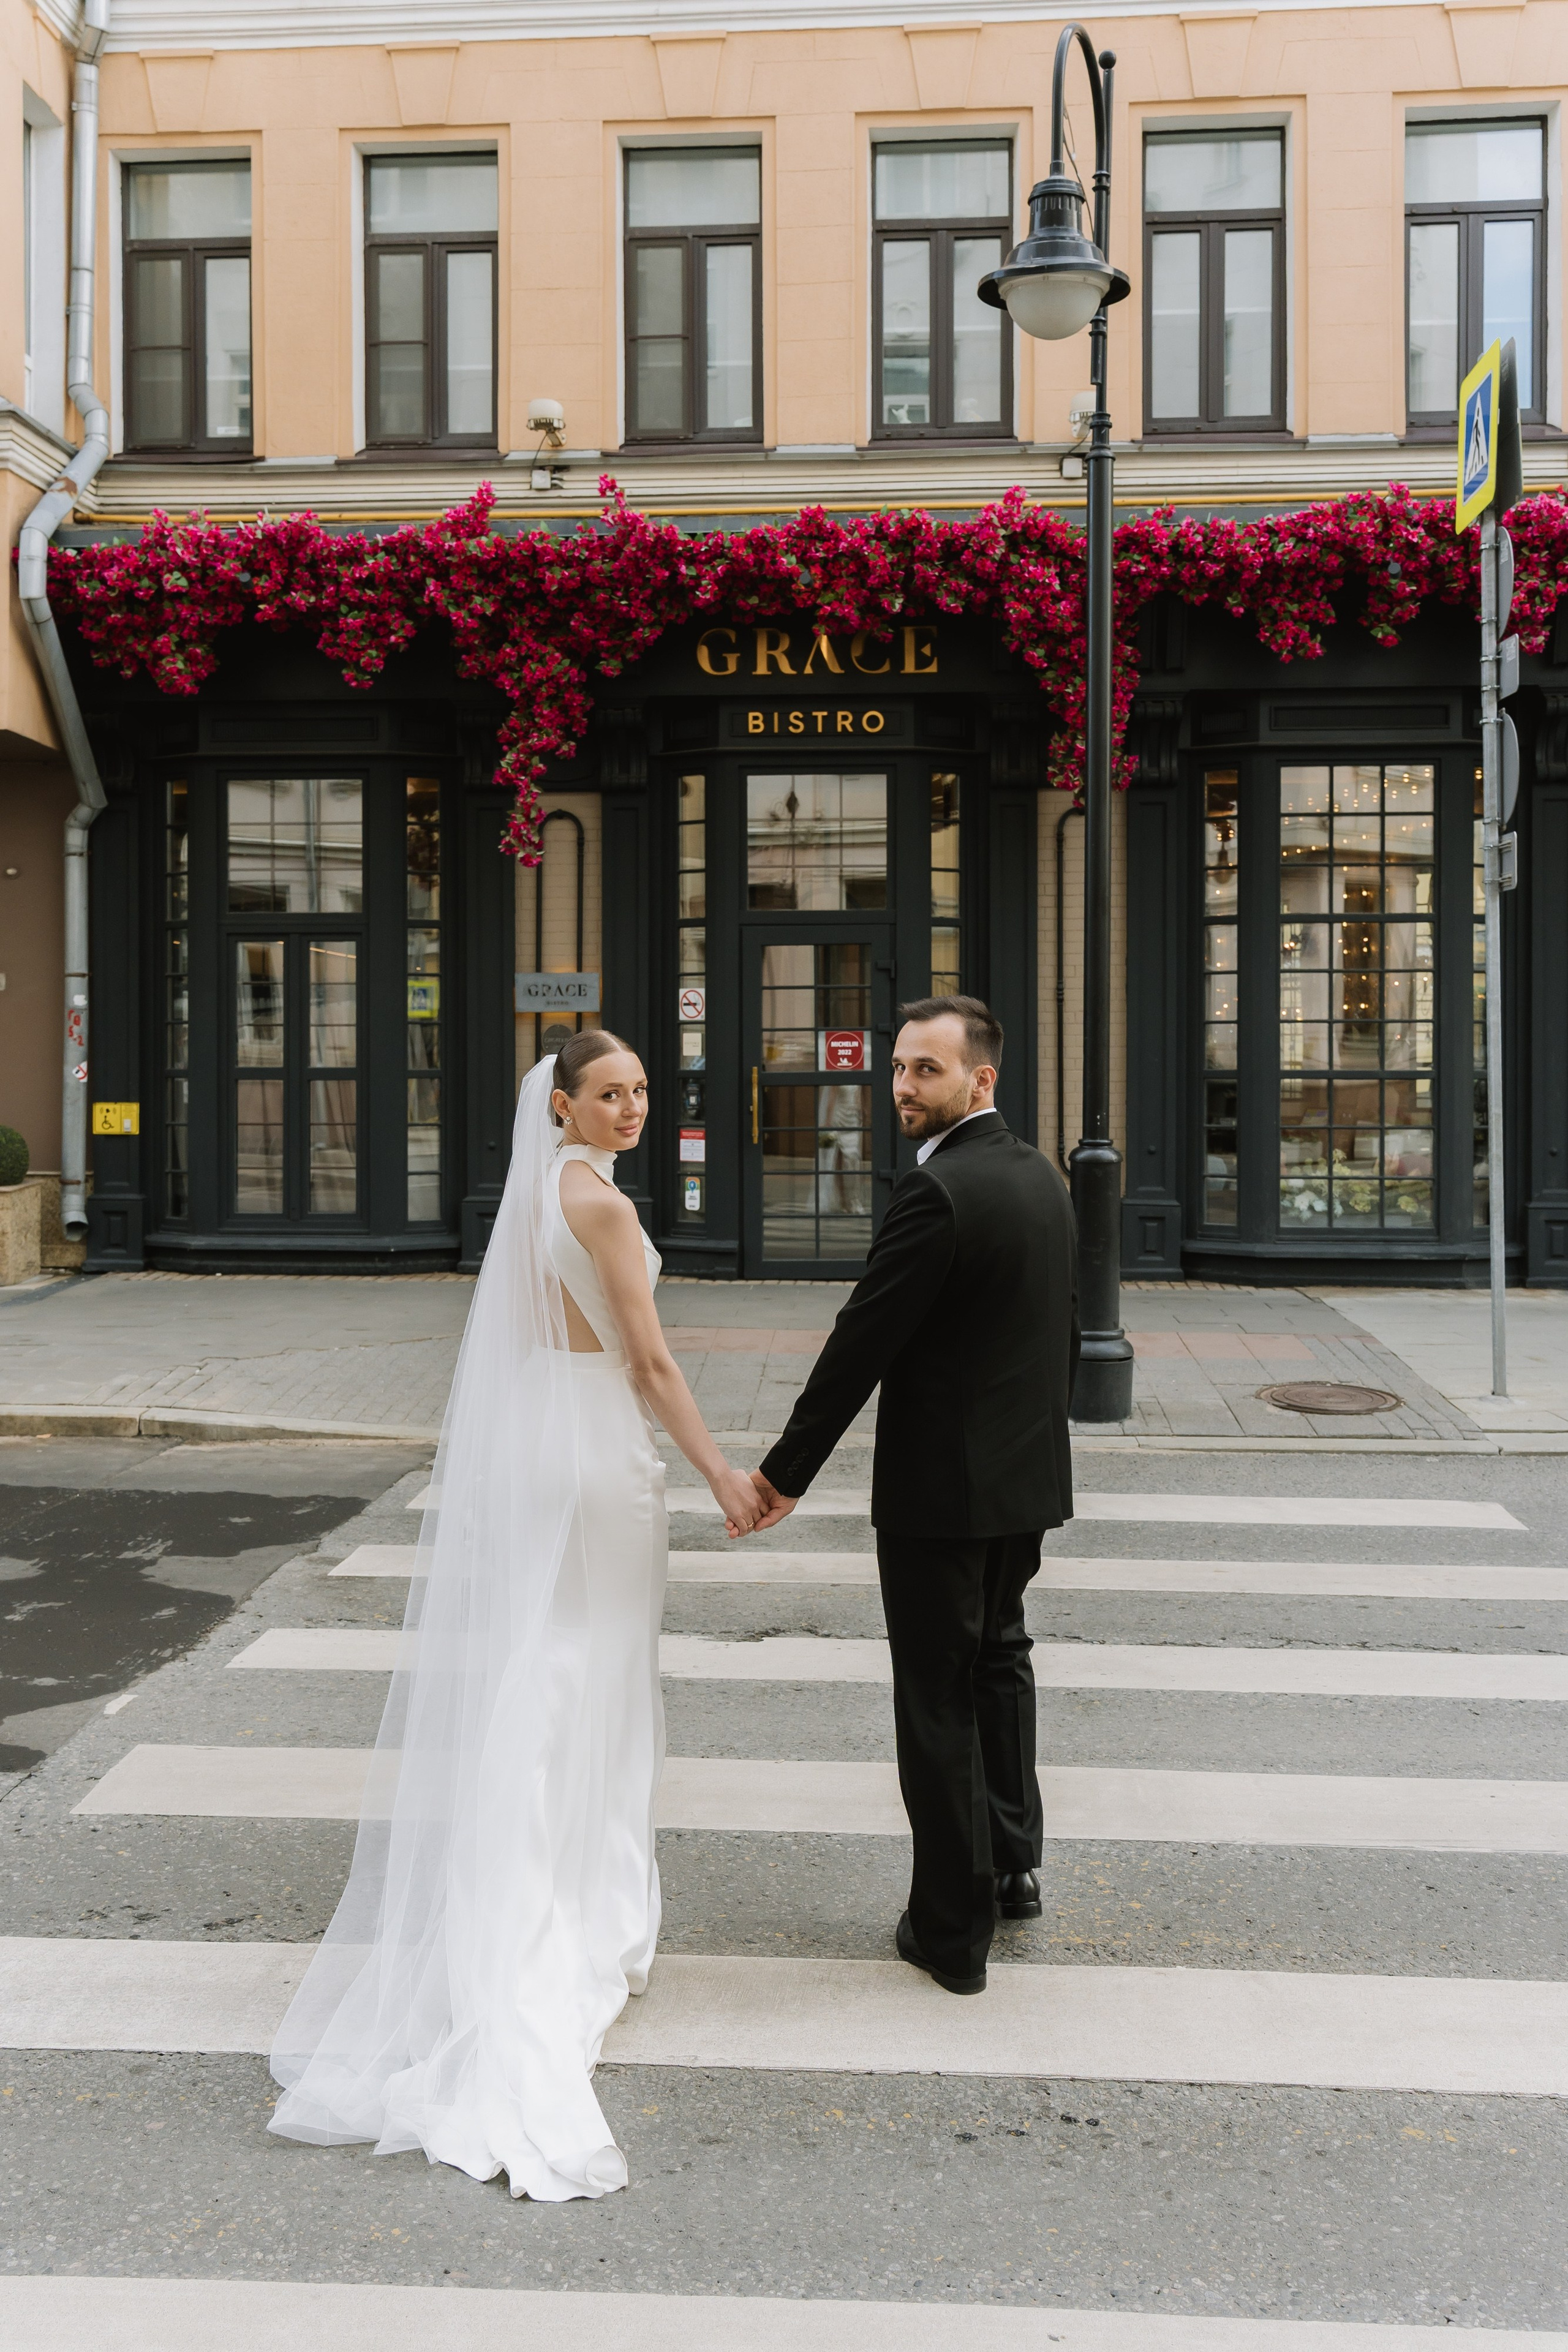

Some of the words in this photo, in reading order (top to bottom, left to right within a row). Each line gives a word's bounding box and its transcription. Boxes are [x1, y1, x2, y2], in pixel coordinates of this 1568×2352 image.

[696, 626, 938, 676] GRACE
[748, 710, 884, 733] BISTRO
[527, 984, 587, 997] GRACE
